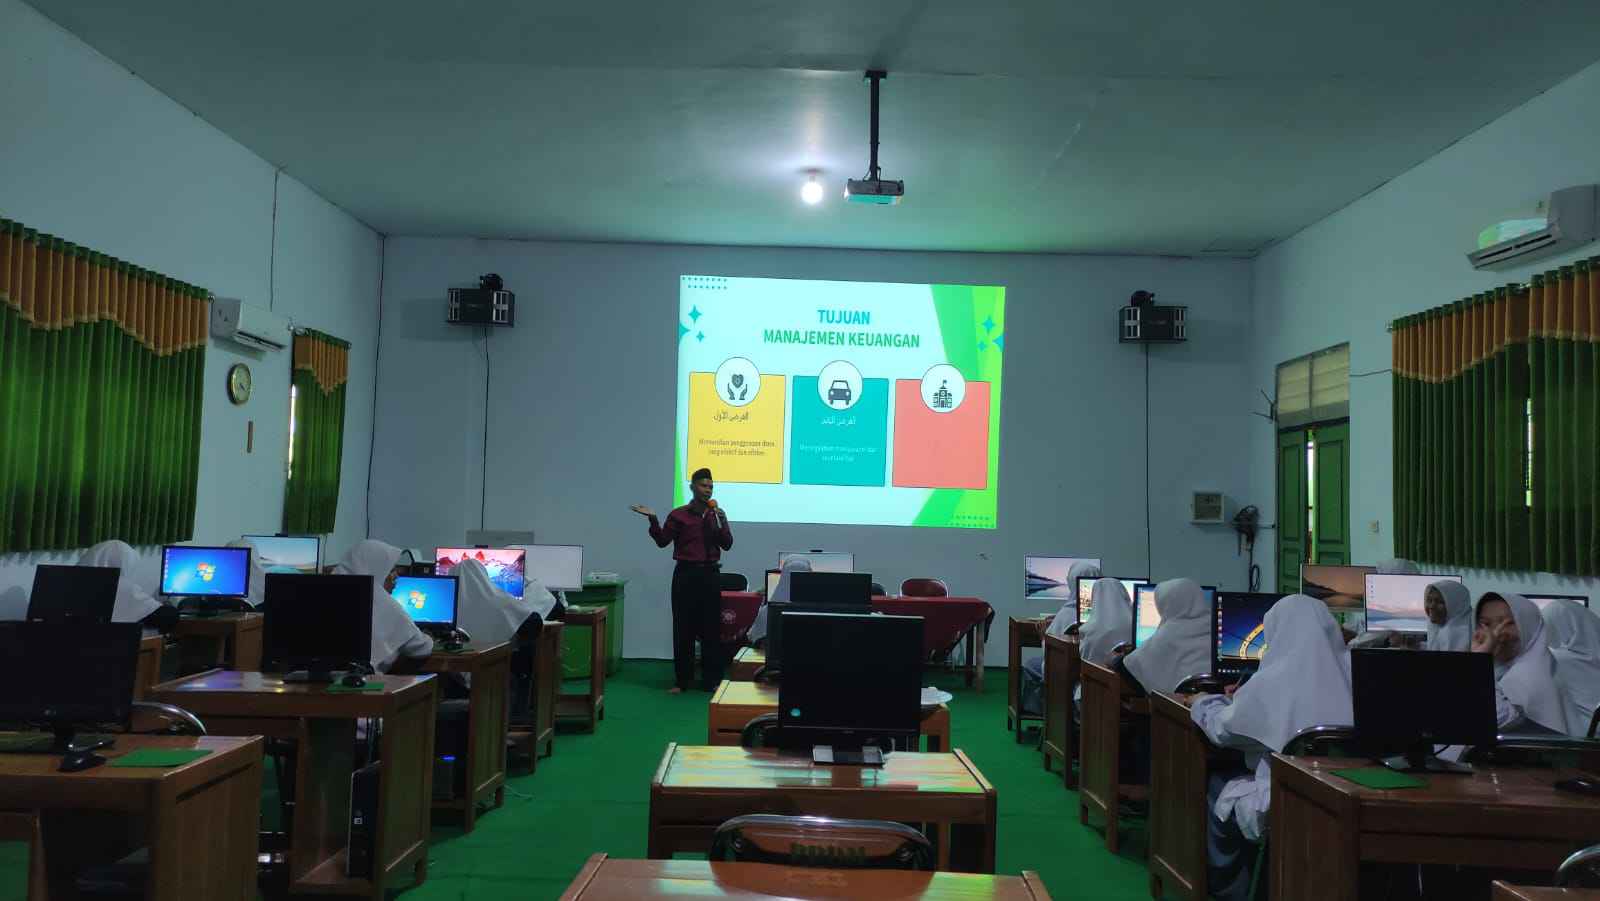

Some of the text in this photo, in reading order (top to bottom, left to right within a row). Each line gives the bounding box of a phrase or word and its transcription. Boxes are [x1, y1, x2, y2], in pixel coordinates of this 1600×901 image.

[817, 309, 871, 325] TUJUAN
[763, 329, 920, 348] MANAJEMEN KEUANGAN
